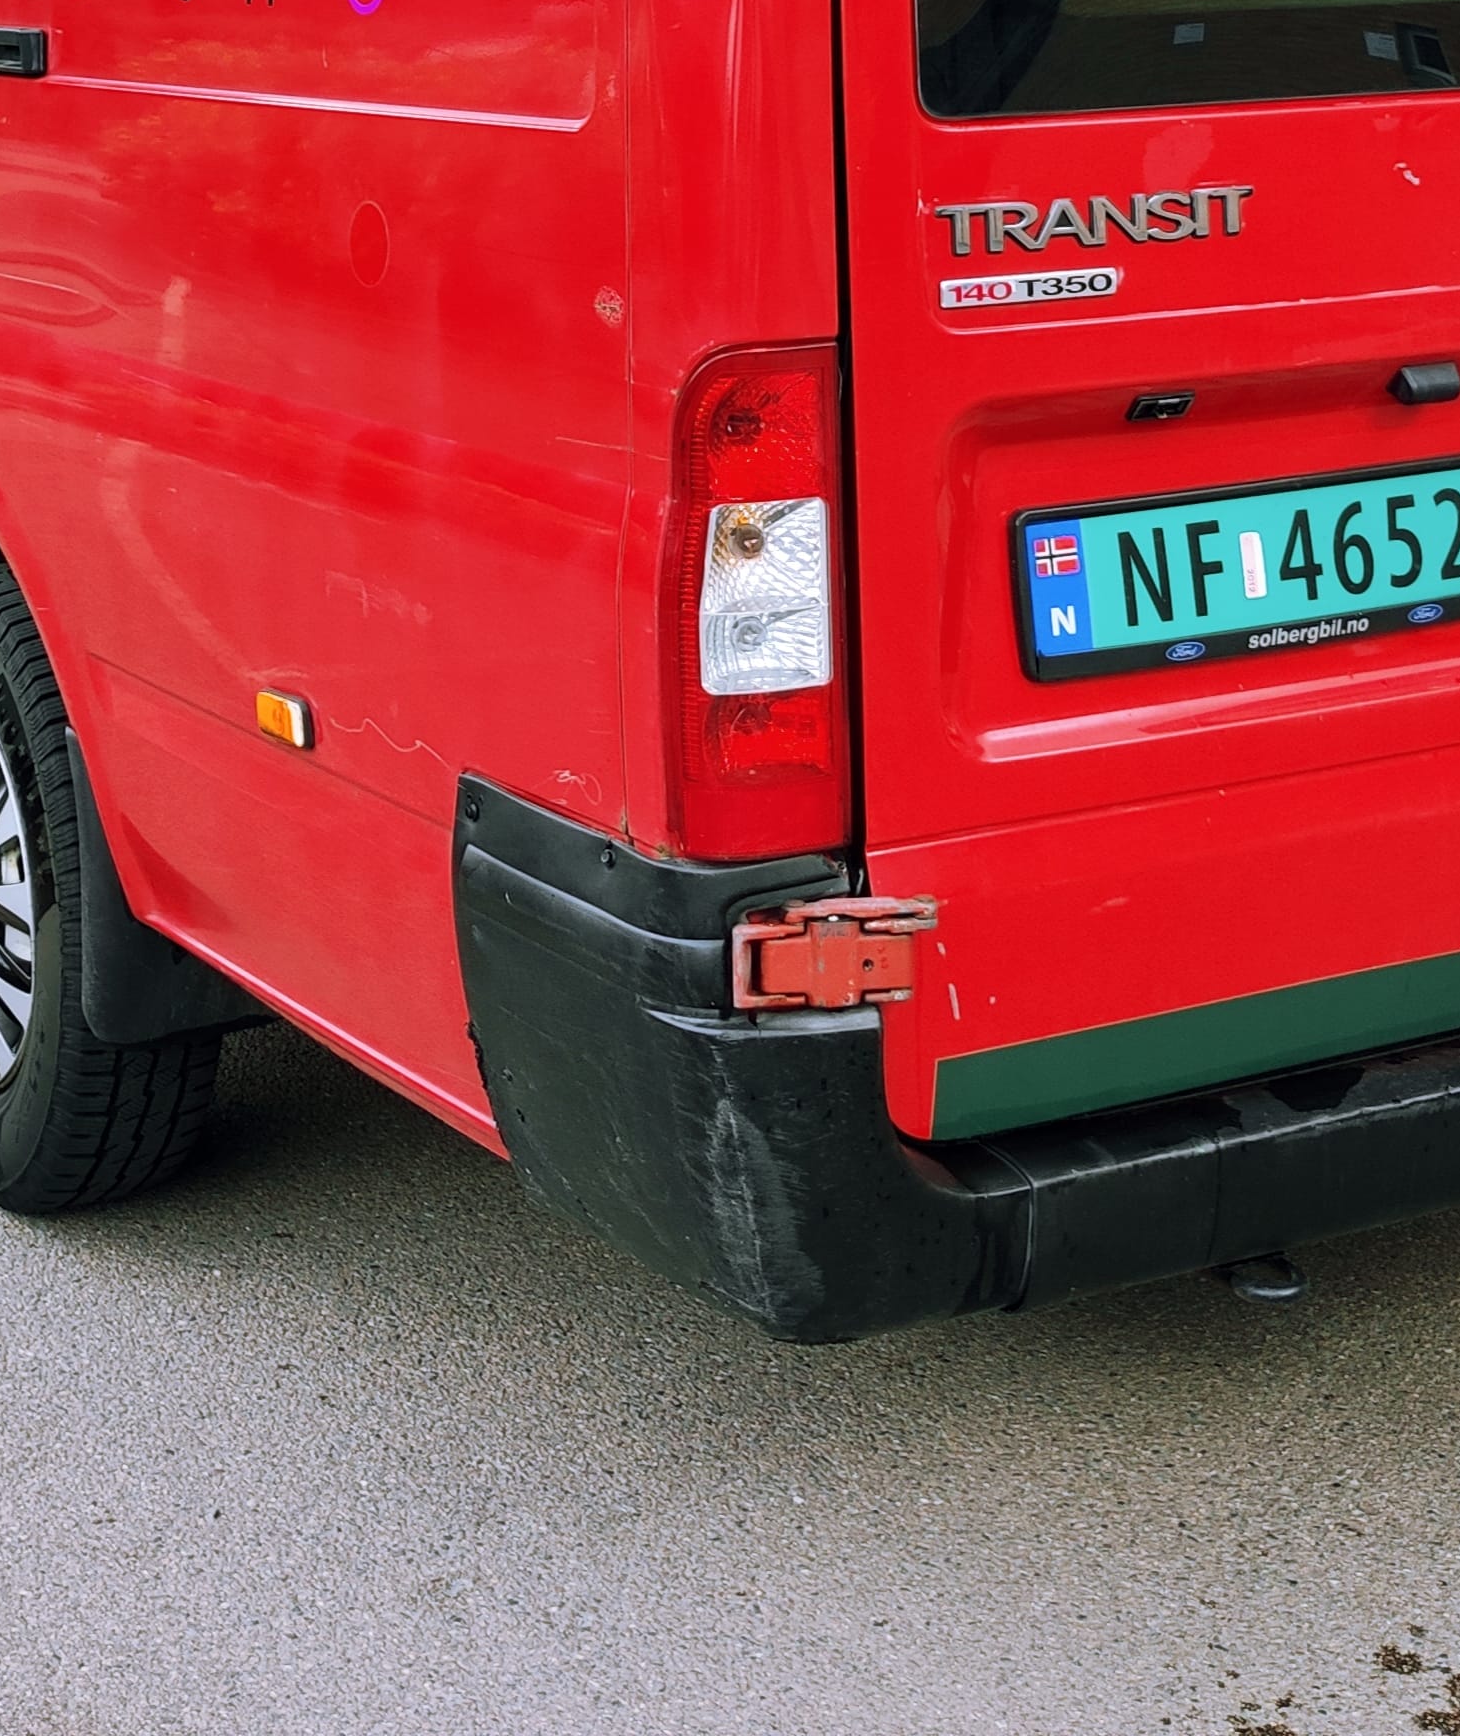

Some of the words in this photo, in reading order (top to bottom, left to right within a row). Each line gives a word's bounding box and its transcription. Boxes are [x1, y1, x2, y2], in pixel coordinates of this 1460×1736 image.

[935, 184, 1254, 256] TRANSIT
[947, 281, 1013, 305] 140
[1019, 271, 1114, 299] T350
[1116, 518, 1225, 628] NF
[1049, 605, 1077, 637] N
[1248, 614, 1370, 650] solbergbil.no
